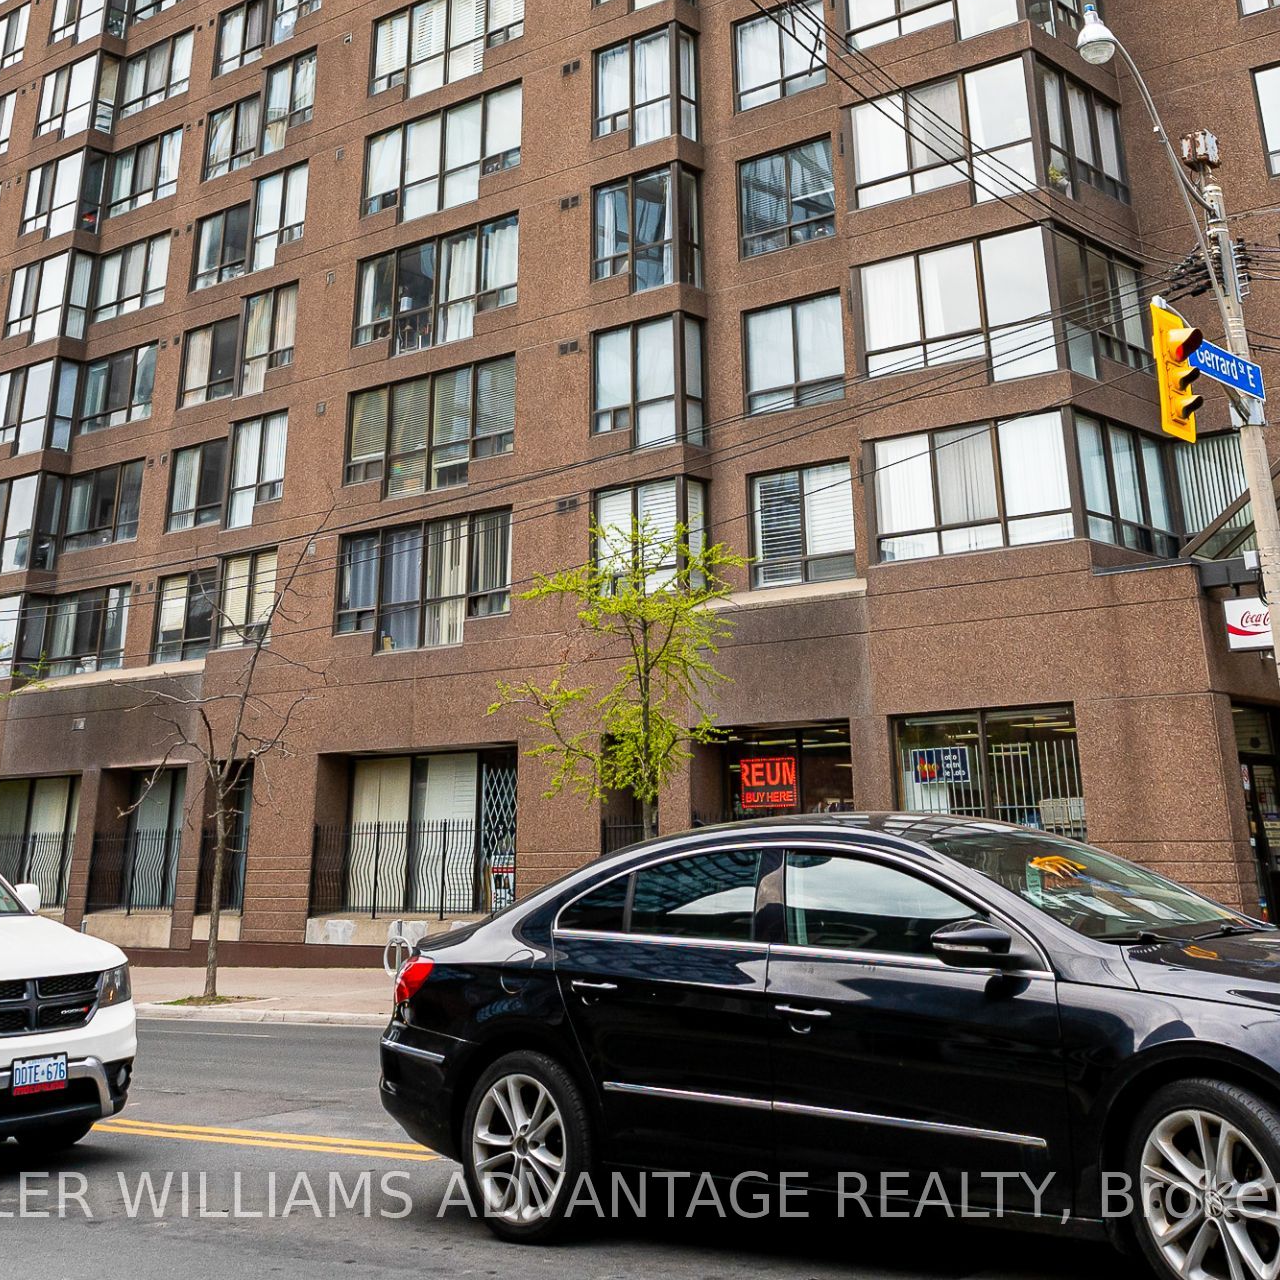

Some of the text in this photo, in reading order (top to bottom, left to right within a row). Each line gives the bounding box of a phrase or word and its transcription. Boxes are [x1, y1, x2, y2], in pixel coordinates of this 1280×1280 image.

[1196, 345, 1239, 381] Gerrard
[1246, 364, 1256, 388] E
[745, 790, 794, 803] BUY HERE
[46, 1061, 66, 1081] 676
